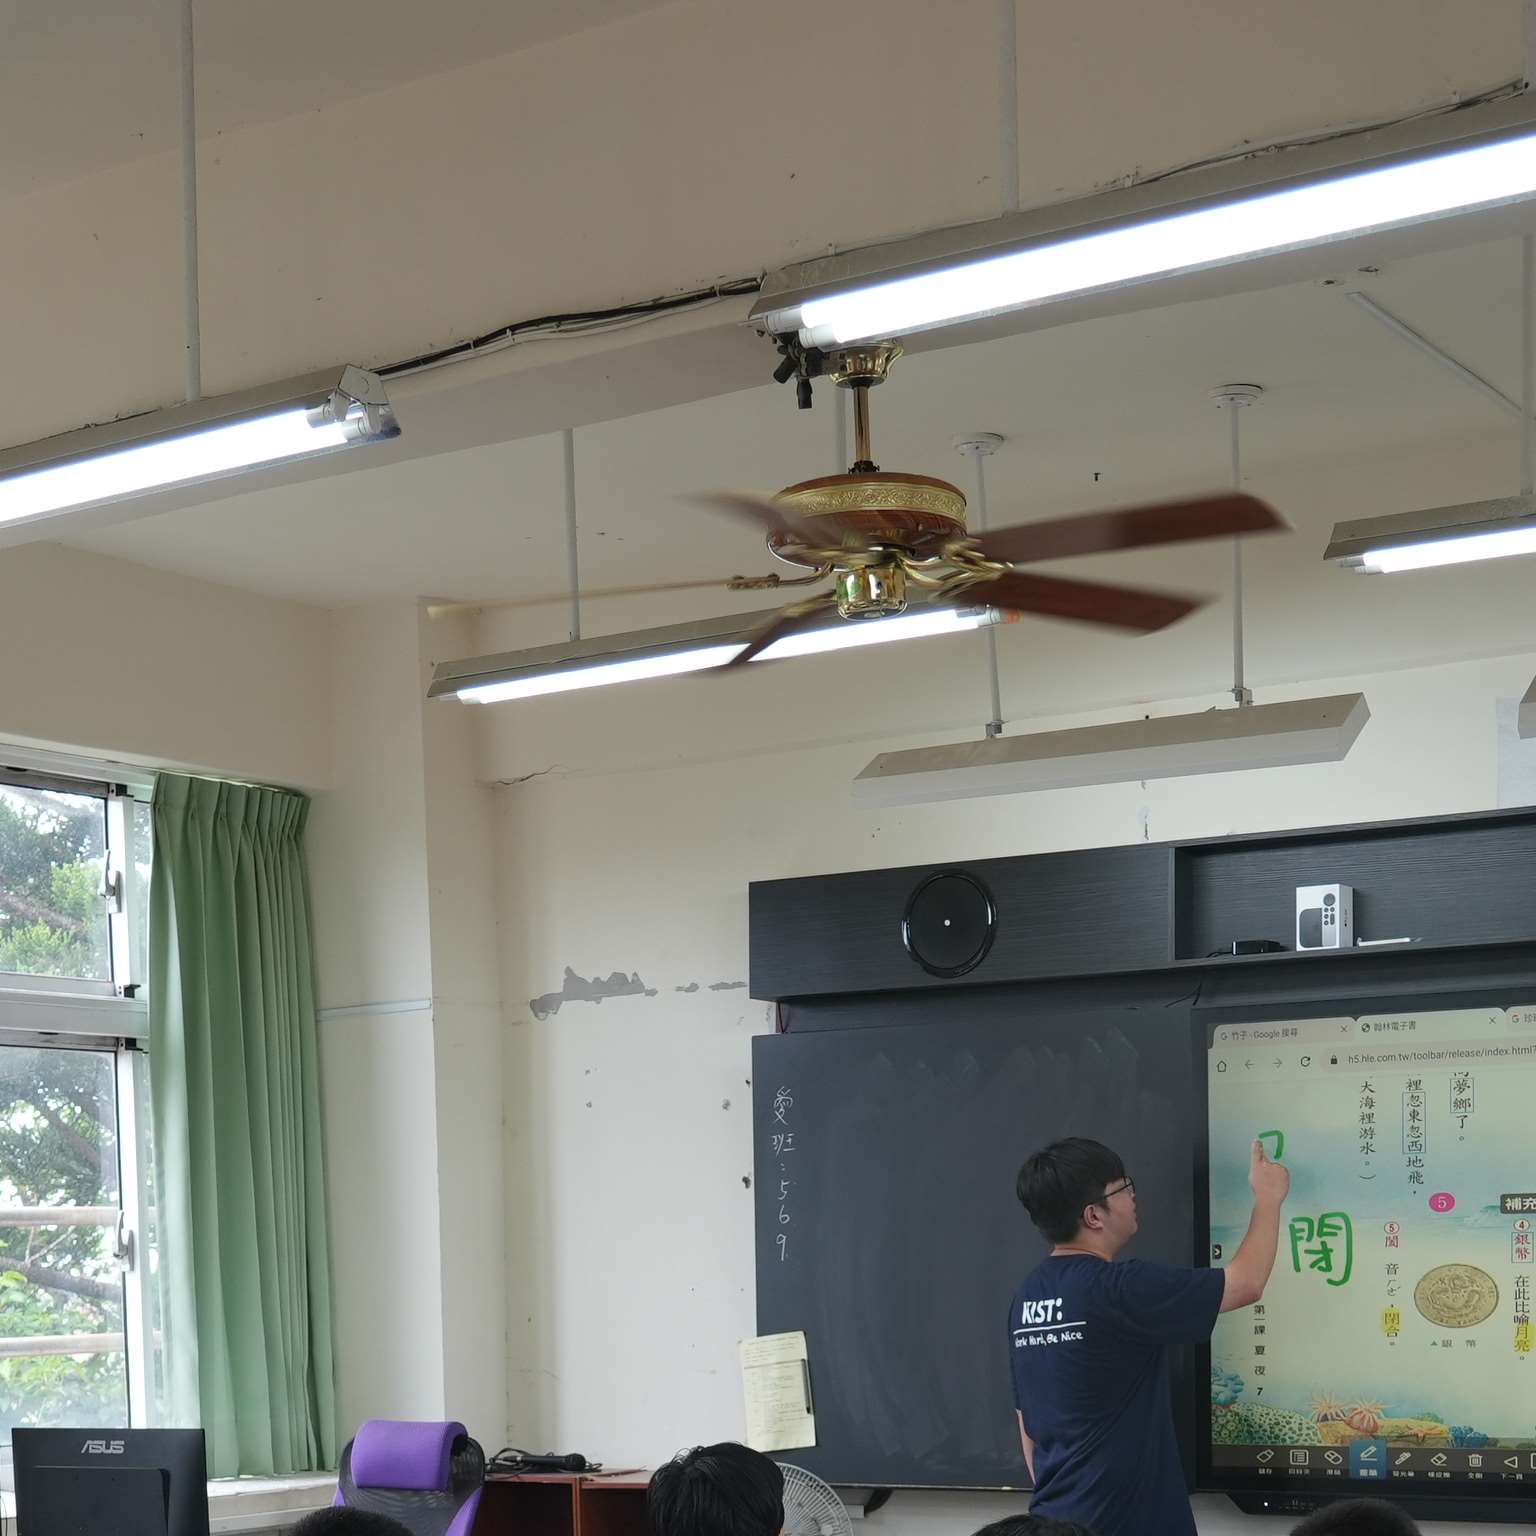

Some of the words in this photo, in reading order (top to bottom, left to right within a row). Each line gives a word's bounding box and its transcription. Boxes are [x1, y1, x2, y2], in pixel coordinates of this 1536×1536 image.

[1373, 1021, 1416, 1032] 翰林電子書
[1253, 1030, 1280, 1039] Google
[1289, 1211, 1353, 1287] 閉
[1047, 1334, 1059, 1344] Be
[1061, 1331, 1084, 1342] Nice
[81, 1440, 125, 1454] ASUS
